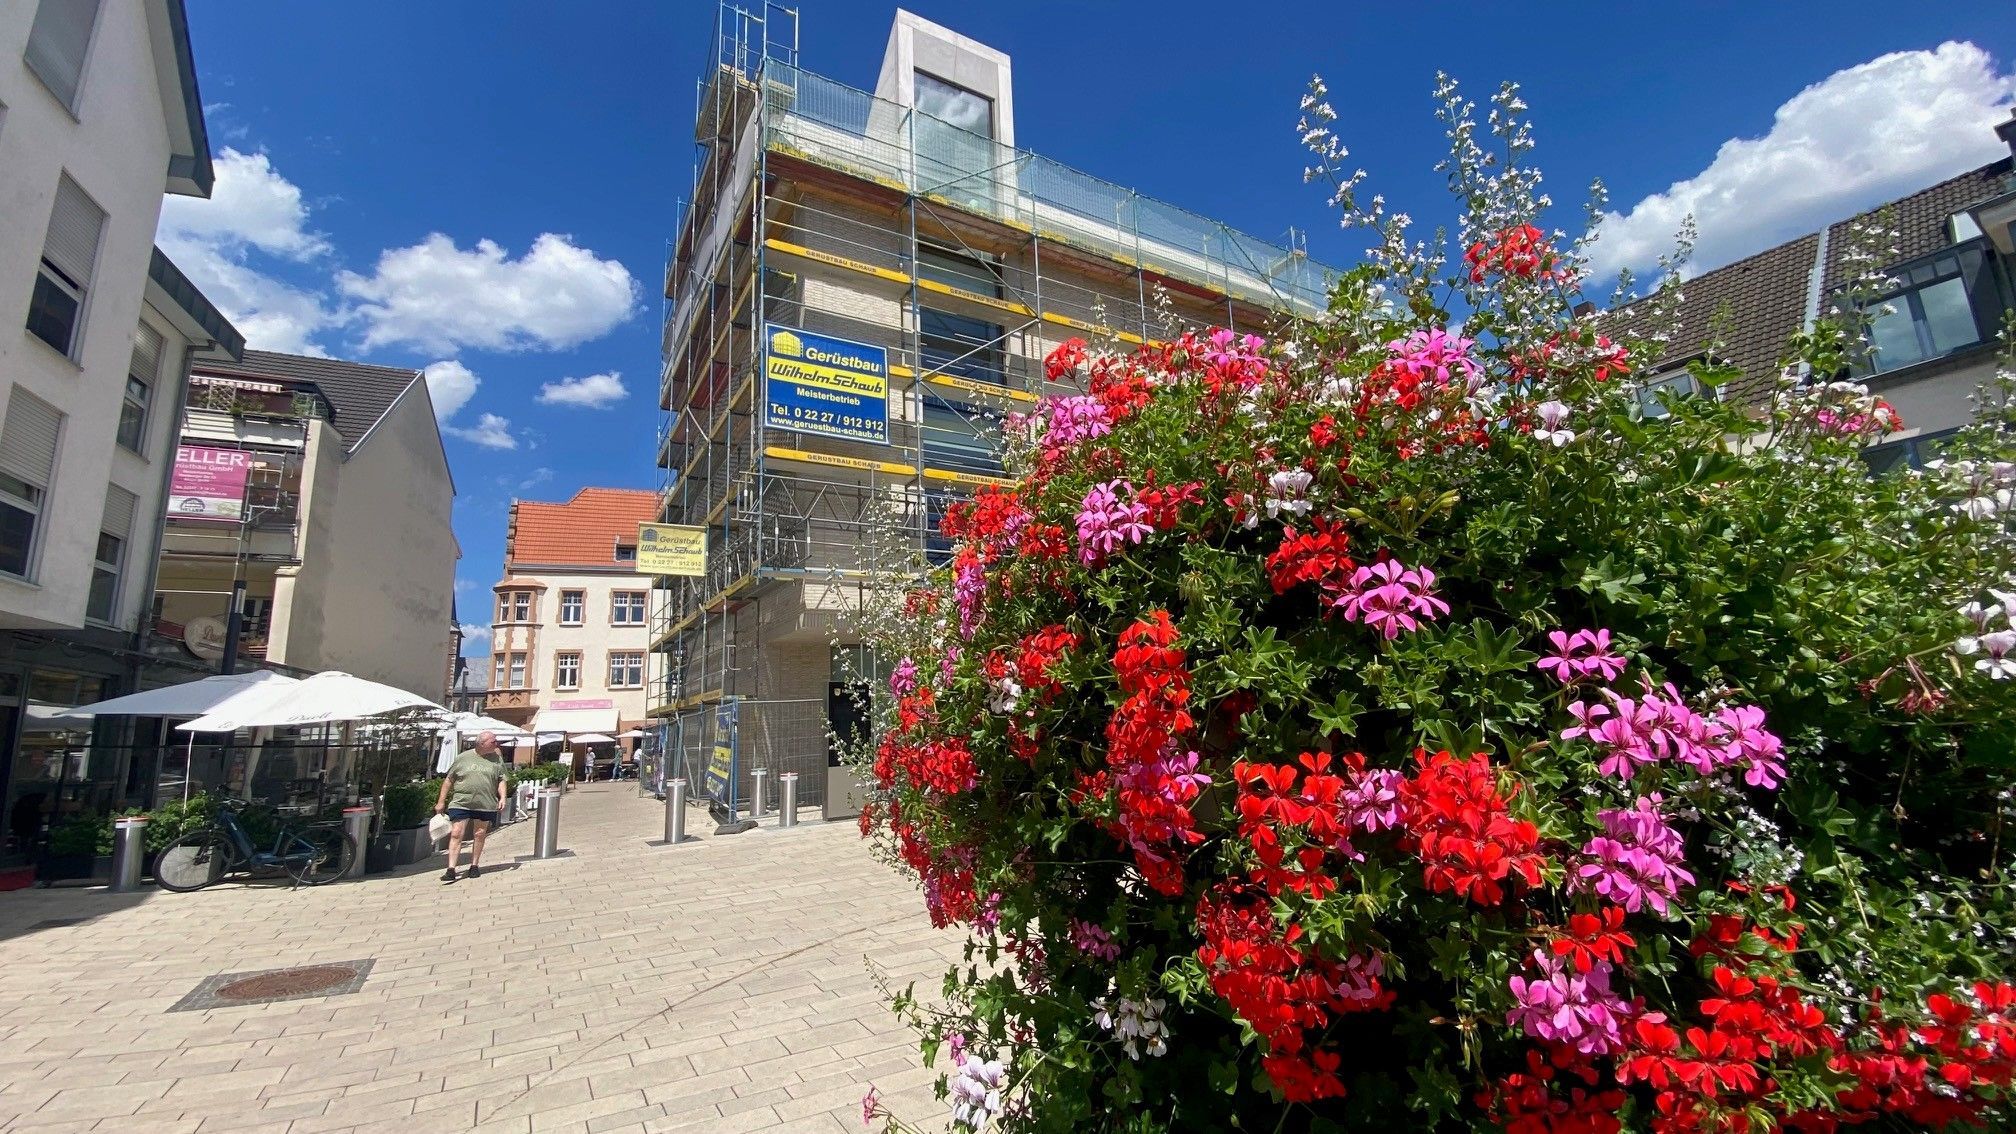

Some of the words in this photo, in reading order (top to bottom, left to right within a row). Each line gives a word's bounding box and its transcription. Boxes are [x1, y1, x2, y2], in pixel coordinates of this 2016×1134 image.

[805, 347, 880, 373] Gerüstbau
[770, 362, 830, 384] Wilhelm
[829, 374, 883, 394] Schaub
[796, 387, 860, 406] Meisterbetrieb
[770, 403, 791, 416] Tel.
[794, 408, 801, 418] 0
[804, 409, 818, 421] 22
[821, 412, 834, 423] 27
[836, 414, 841, 424] /
[843, 415, 862, 427] 912
[865, 419, 884, 431] 912
[770, 416, 884, 440] www.geruestbau-schaub.de
[640, 544, 673, 554] Wilhelm
[672, 546, 703, 555] Schaub
[659, 536, 701, 545] Gerüstbau
